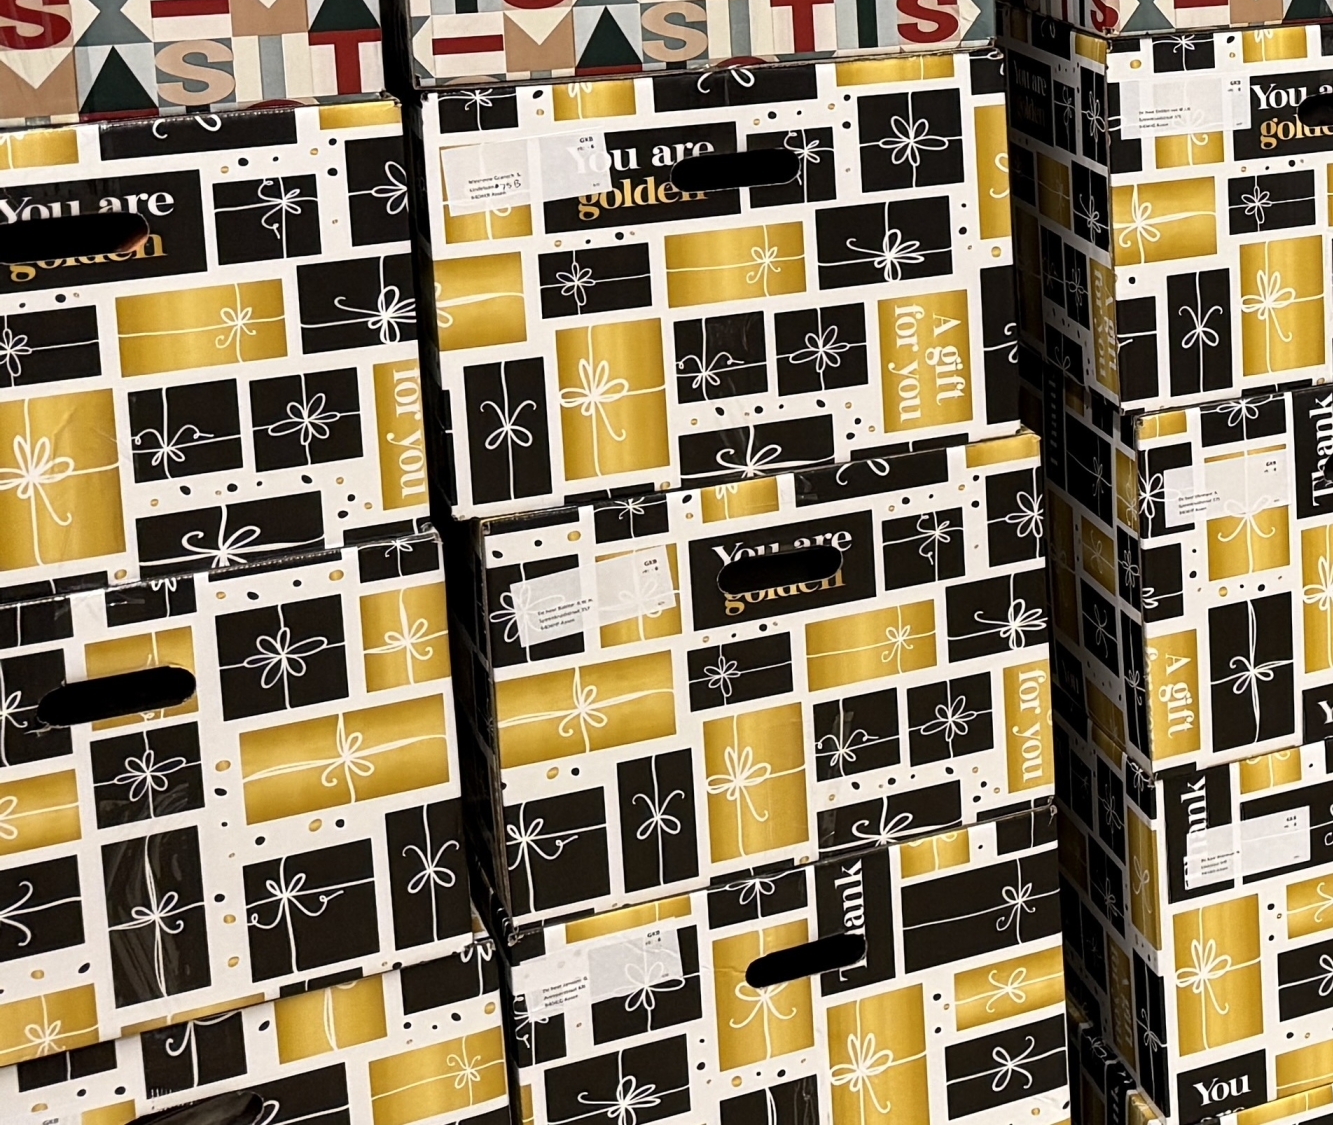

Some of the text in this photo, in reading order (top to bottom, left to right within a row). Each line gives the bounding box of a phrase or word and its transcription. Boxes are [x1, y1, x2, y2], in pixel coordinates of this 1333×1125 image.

[888, 303, 925, 422] for you
[924, 312, 966, 406] A gift
[1165, 653, 1191, 675] A
[1013, 669, 1047, 783] for you
[1158, 681, 1195, 740] gift
[1193, 1075, 1252, 1107] You
